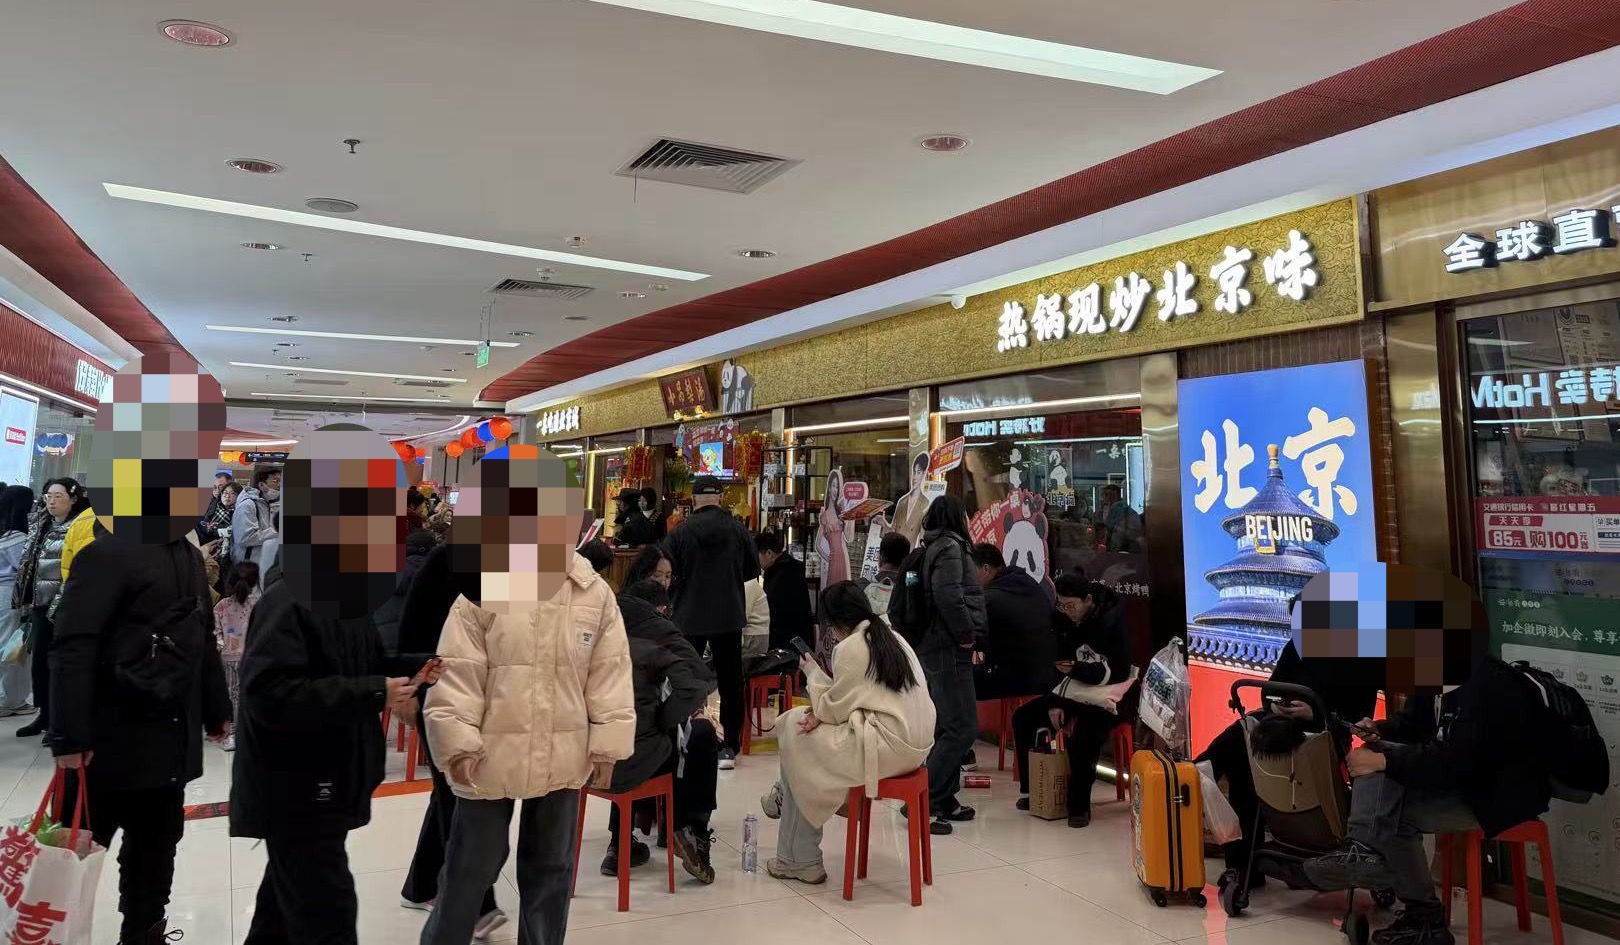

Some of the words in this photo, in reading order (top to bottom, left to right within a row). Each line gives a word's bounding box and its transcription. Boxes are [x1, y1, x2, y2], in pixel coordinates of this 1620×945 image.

[1443, 205, 1620, 272] 全球直
[997, 229, 1317, 353] 热锅现炒北京味
[1190, 406, 1358, 521] 北京
[1245, 515, 1314, 542] BEIJING
